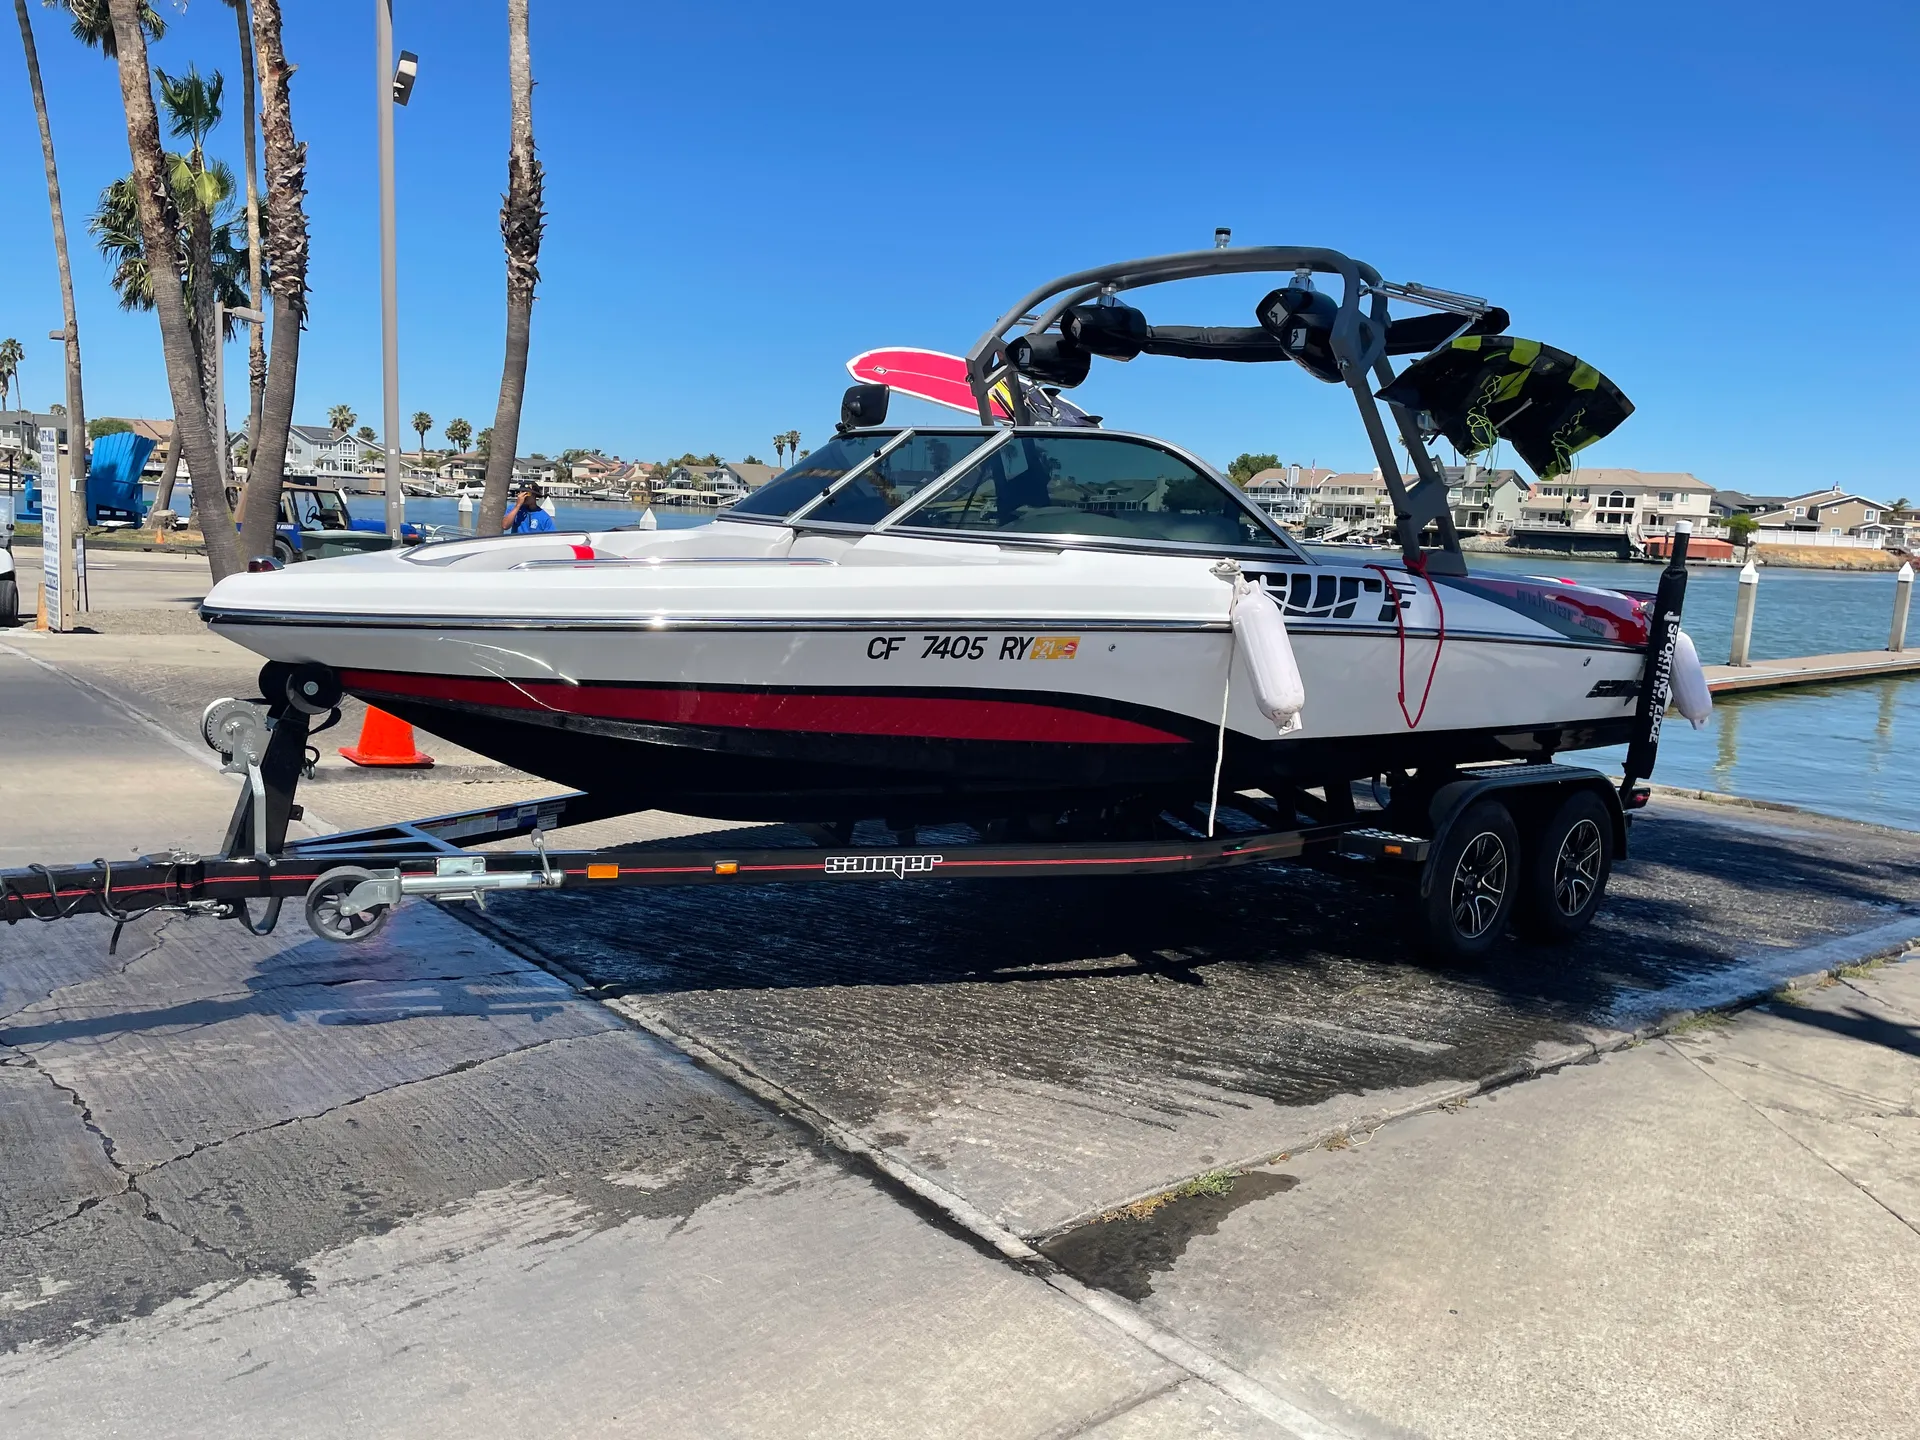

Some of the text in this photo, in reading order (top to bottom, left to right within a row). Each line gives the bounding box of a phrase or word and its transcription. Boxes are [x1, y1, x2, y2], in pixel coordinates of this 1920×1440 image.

[867, 636, 1035, 660] CF 7405 RY
[1649, 623, 1678, 743] SPORTING EDGE
